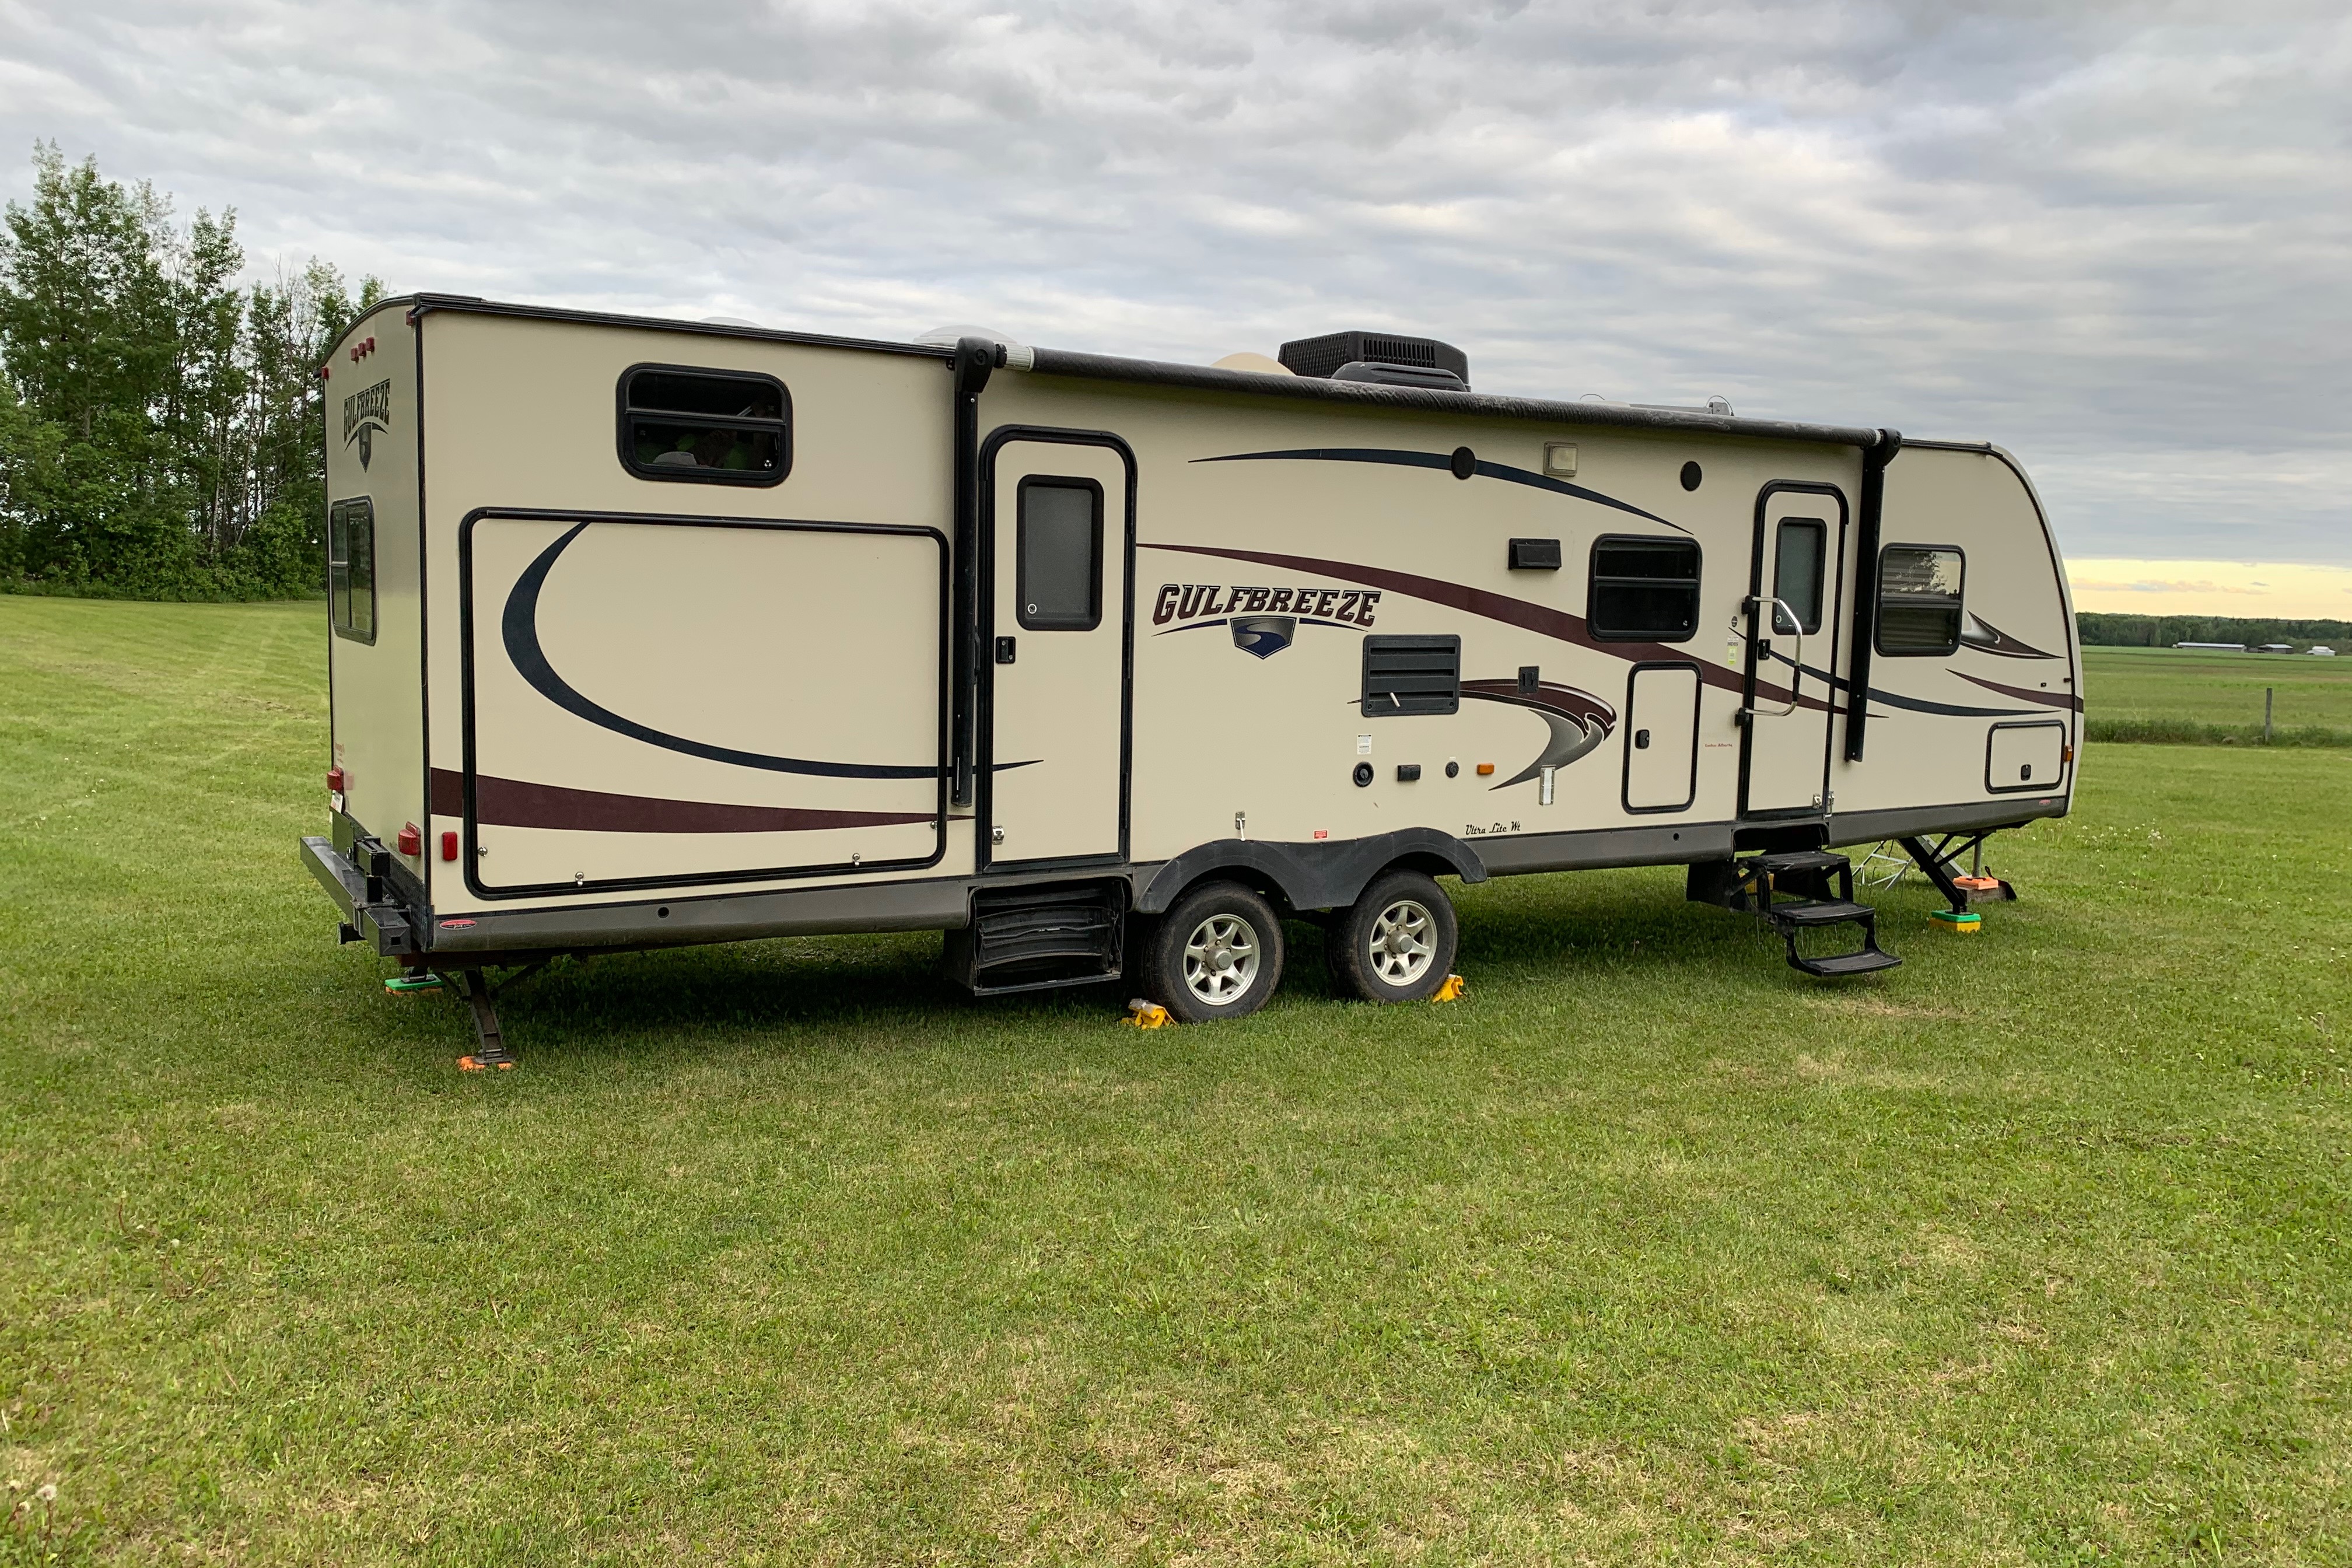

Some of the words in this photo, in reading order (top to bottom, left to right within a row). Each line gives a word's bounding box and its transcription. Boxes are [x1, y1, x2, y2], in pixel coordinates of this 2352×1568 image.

[344, 378, 390, 443] GULFBREEZE
[1152, 584, 1381, 627] GULFBREEZE
[1465, 824, 1486, 835] Ultra
[1489, 822, 1507, 834] Lite
[1511, 821, 1521, 832] Wt
